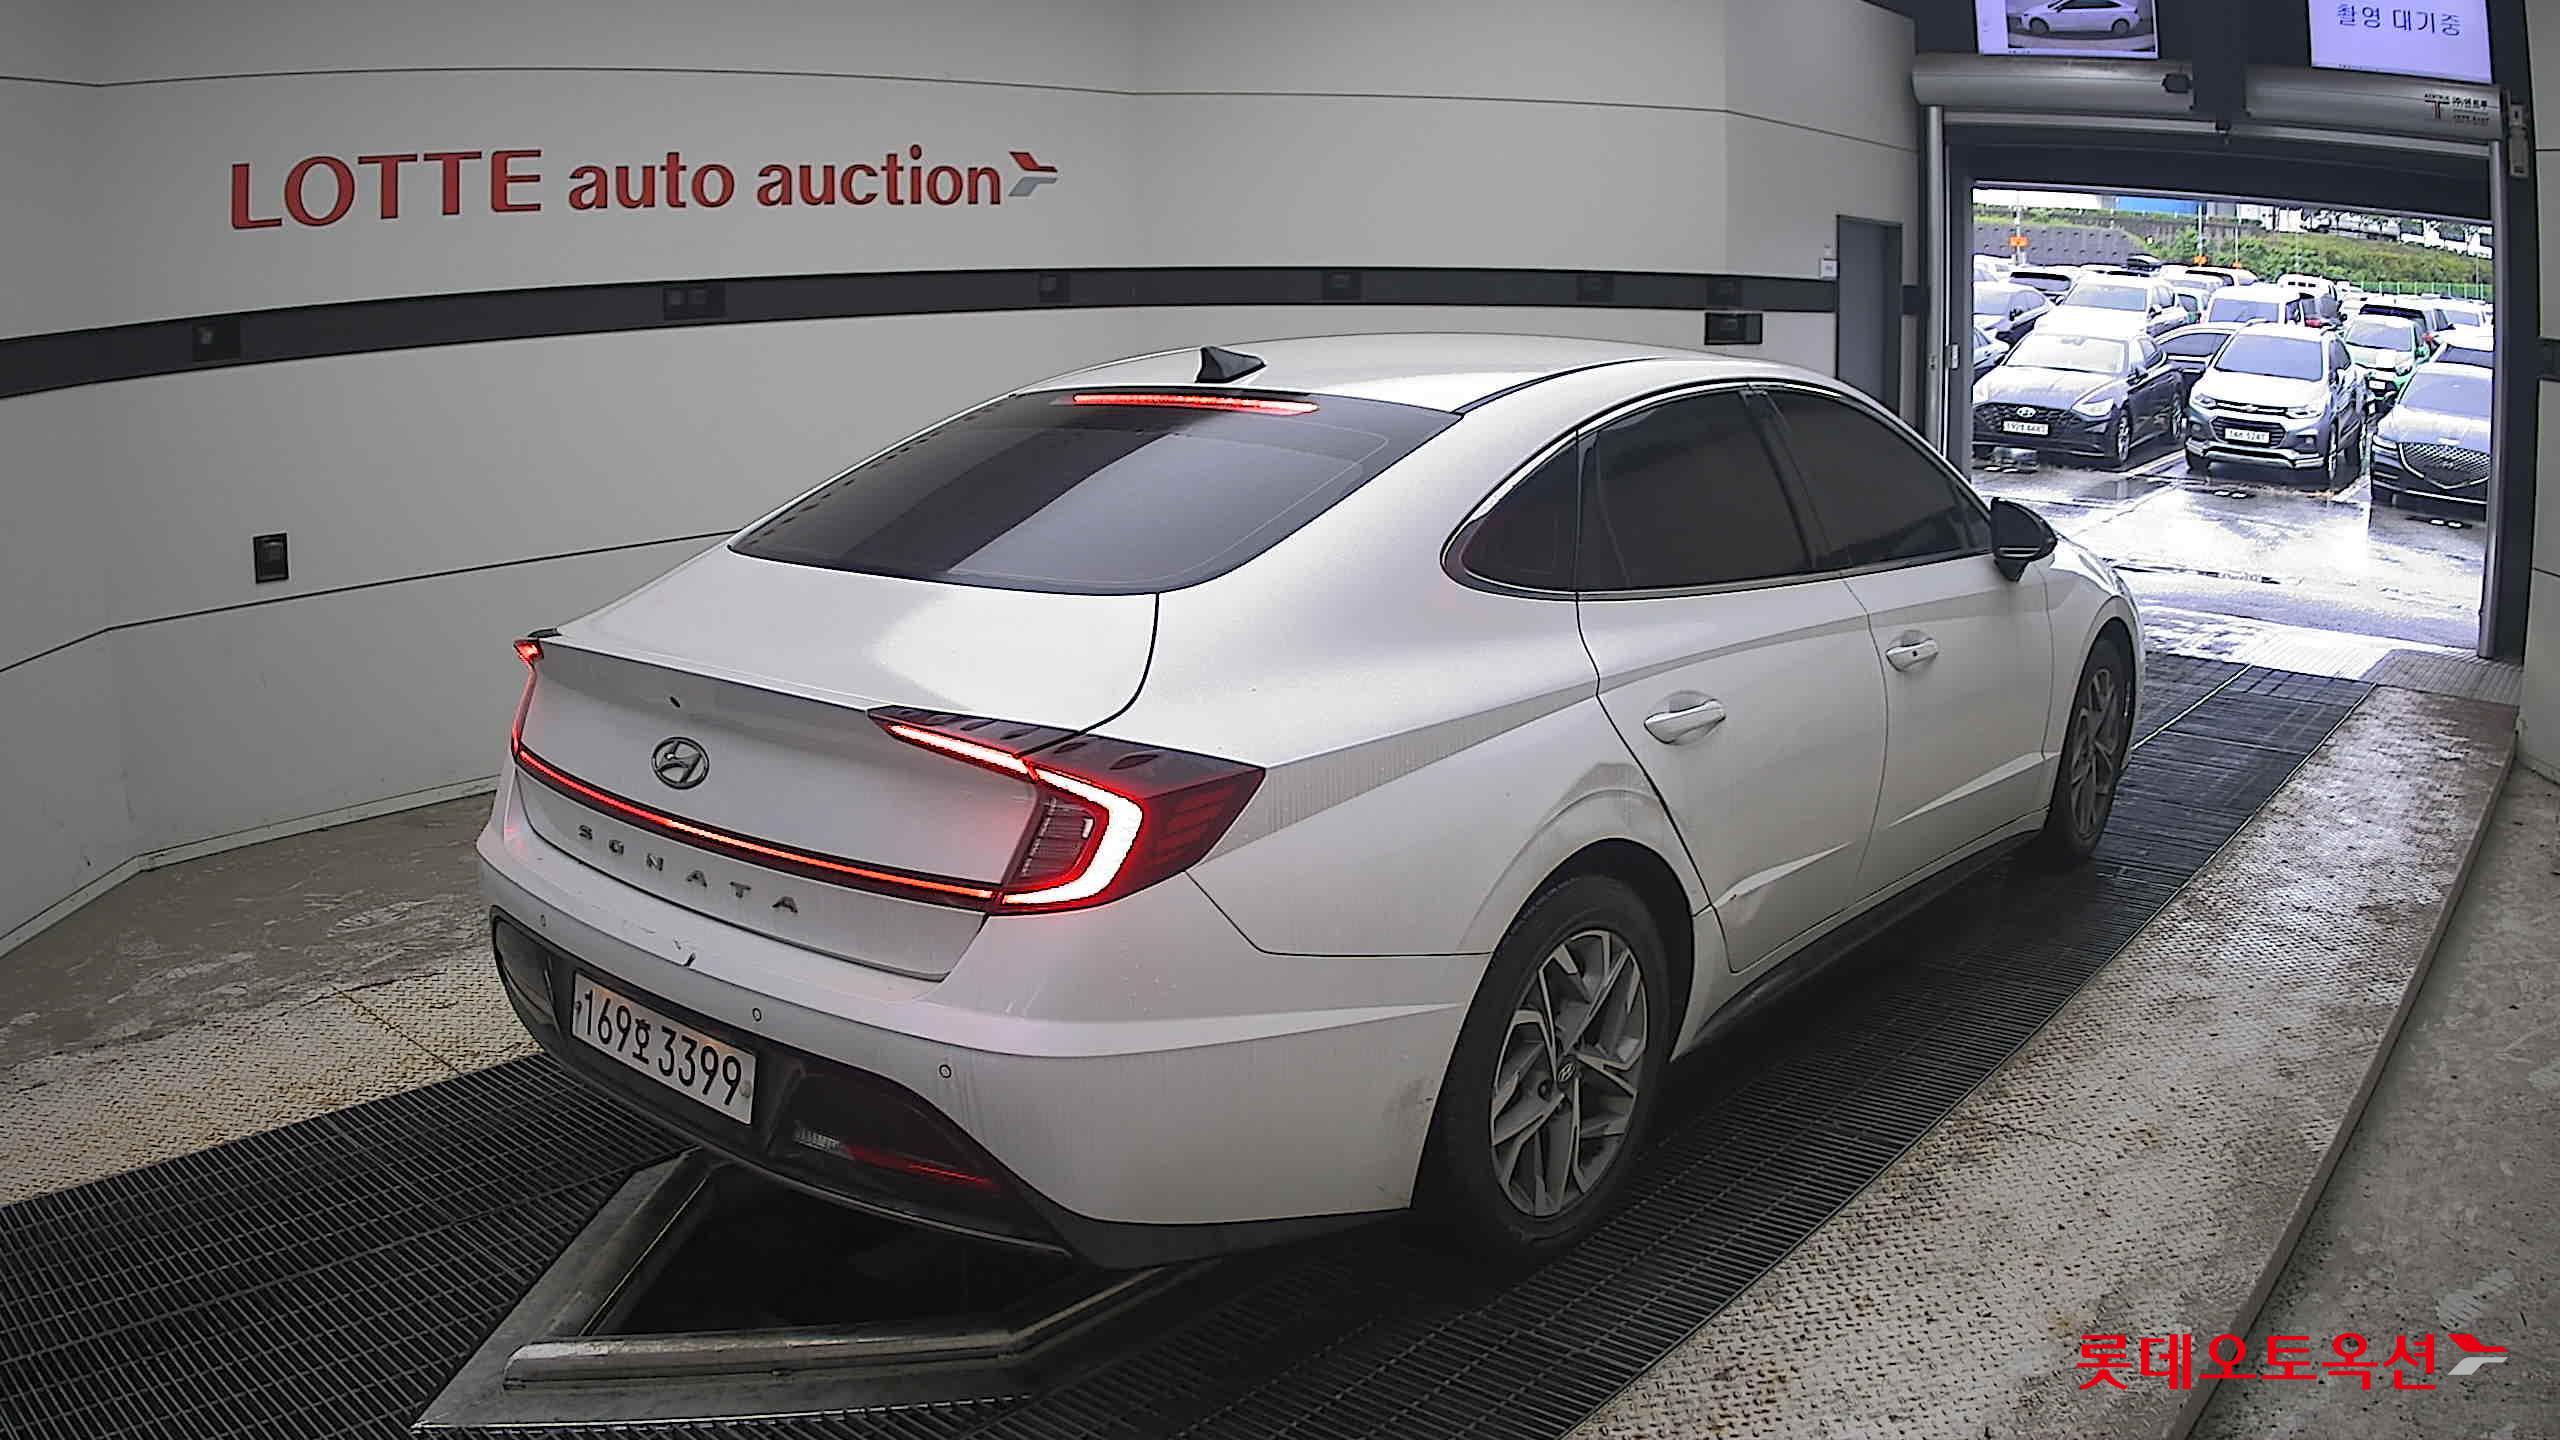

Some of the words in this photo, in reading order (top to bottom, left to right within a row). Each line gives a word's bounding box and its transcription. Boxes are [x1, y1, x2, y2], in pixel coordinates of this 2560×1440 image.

[2337, 4, 2381, 28] 촬영
[231, 149, 541, 230] LOTTE
[568, 152, 734, 210] auto
[756, 144, 1001, 206] auction
[578, 824, 799, 913] SONATA
